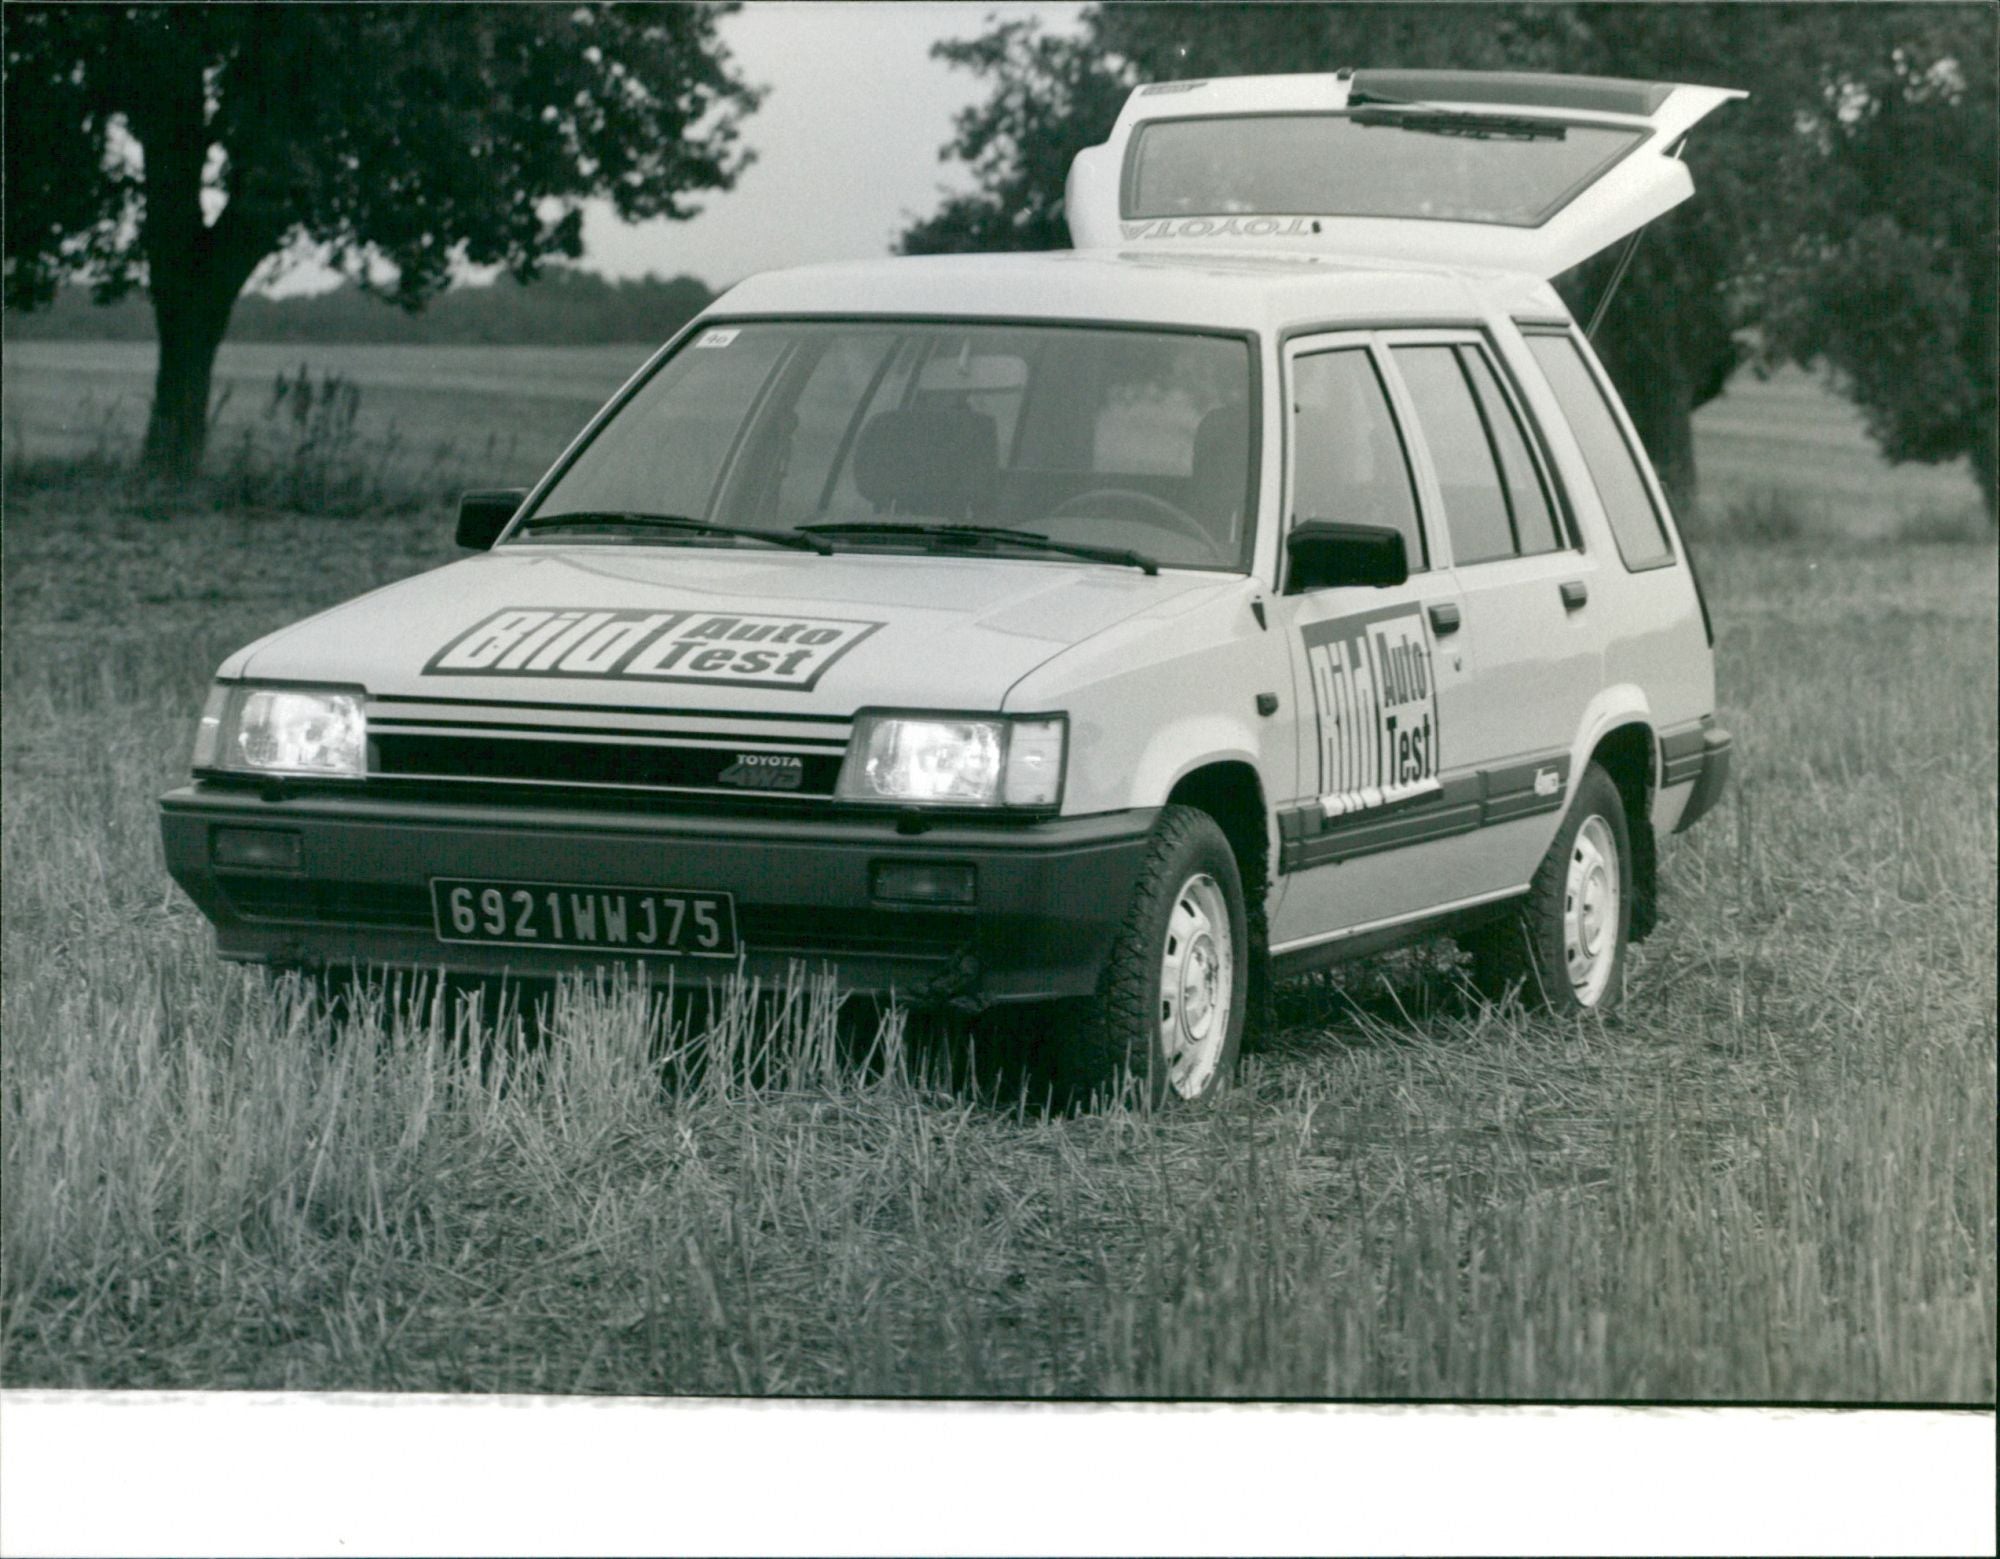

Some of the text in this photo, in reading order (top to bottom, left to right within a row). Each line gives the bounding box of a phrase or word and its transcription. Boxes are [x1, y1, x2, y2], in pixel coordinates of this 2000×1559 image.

[1120, 218, 1308, 240] TOYOTA
[436, 611, 675, 672] Bild
[682, 617, 842, 645] Auto
[655, 642, 813, 676] Test
[1376, 632, 1427, 708] Auto
[737, 754, 803, 767] TOYOTA
[1386, 713, 1430, 791] Test
